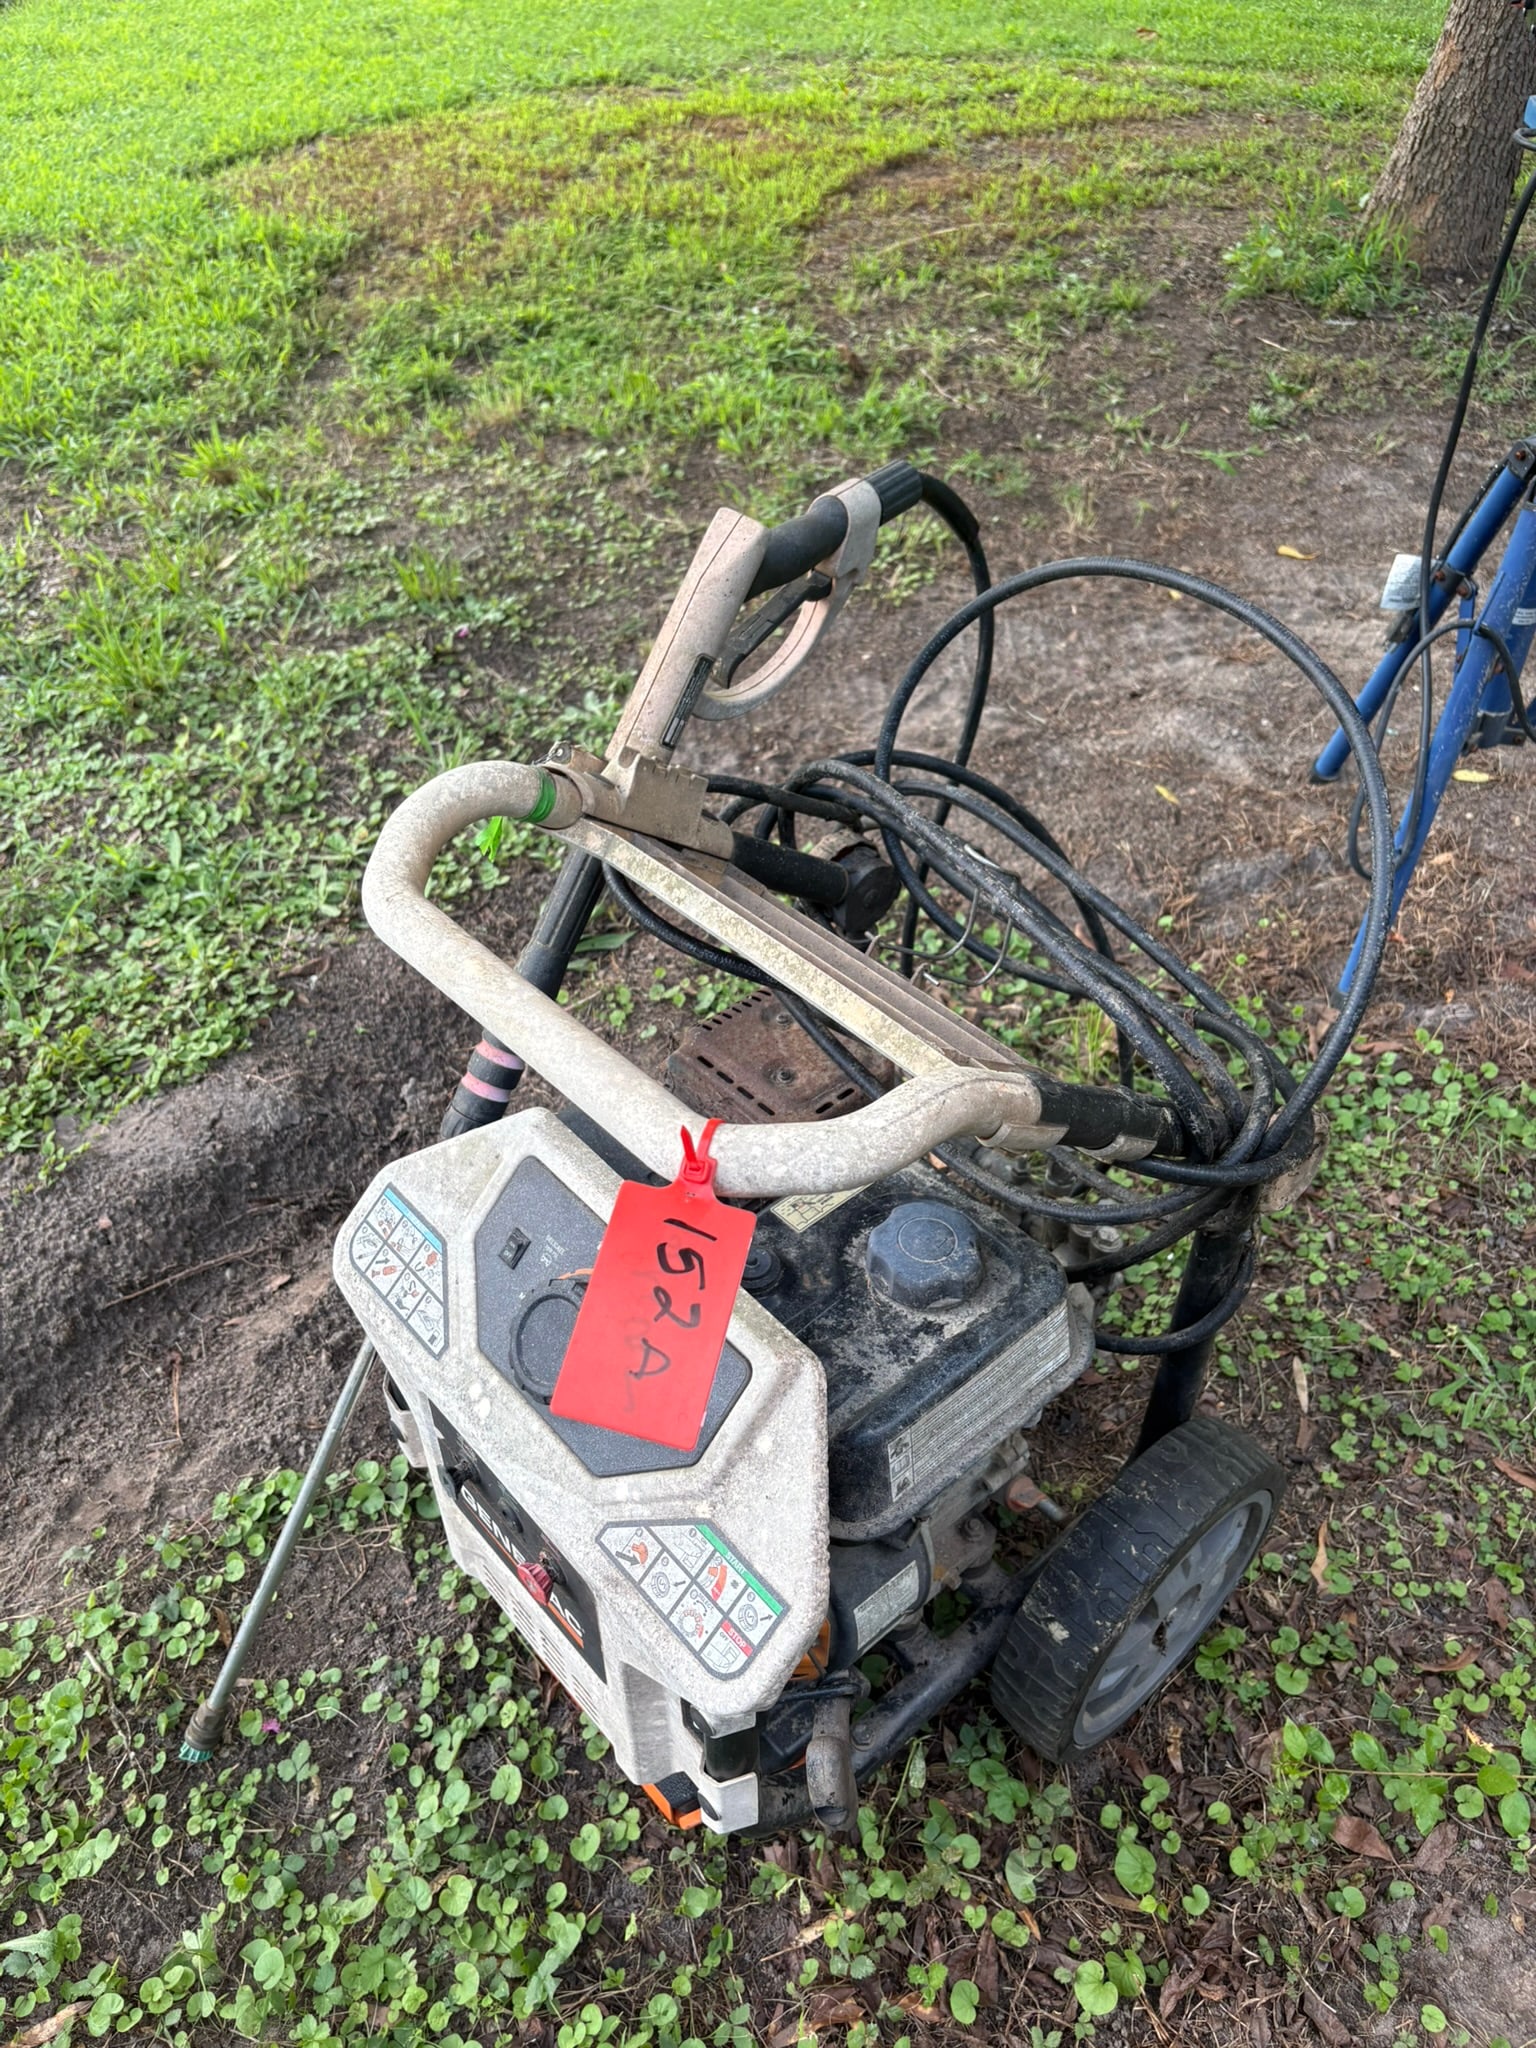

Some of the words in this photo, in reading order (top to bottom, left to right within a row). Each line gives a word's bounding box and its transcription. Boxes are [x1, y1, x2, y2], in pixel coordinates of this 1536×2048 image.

[460, 1484, 584, 1637] GENEAC
[725, 1552, 746, 1575] START
[728, 1628, 748, 1650] STOP
